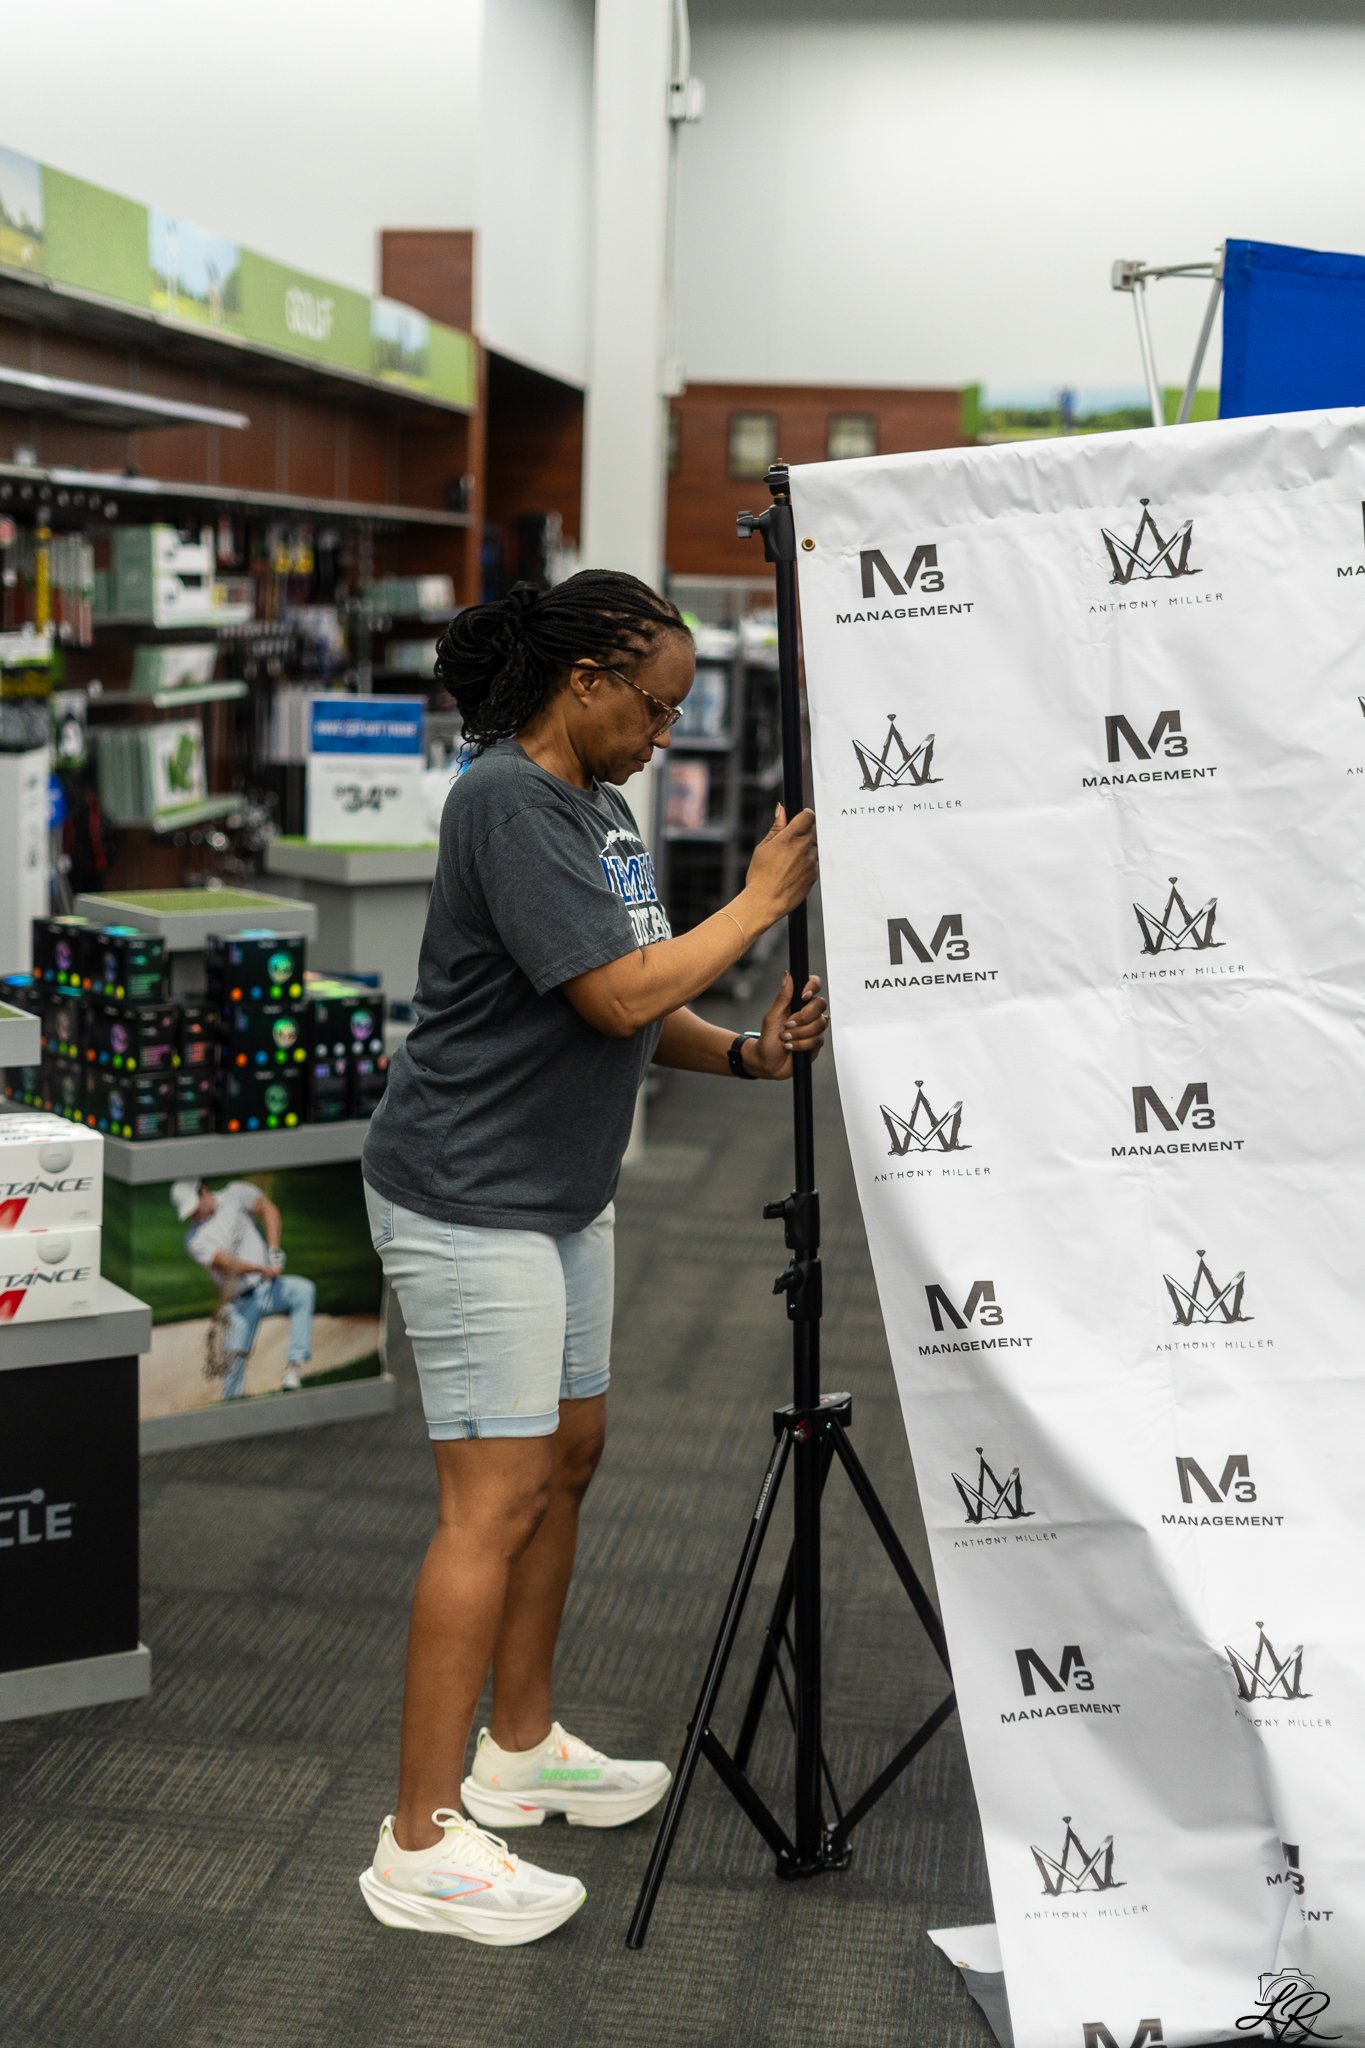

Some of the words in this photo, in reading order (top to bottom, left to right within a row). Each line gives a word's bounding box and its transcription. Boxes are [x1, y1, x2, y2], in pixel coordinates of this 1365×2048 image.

[859, 543, 945, 599] M3
[1088, 599, 1158, 614] ANTHONY
[1168, 592, 1224, 606] MILLER
[835, 602, 975, 625] MANAGEMENT
[1104, 709, 1189, 764] M3
[1082, 766, 1218, 788] MANAGEMENT
[840, 803, 904, 816] ANTHONY
[913, 799, 962, 811] MILLER
[886, 913, 971, 966] M3
[864, 970, 999, 990] MANAGEMENT
[1122, 968, 1185, 980] ANTHONY
[1195, 964, 1245, 975] MILLER
[1131, 1081, 1216, 1134] M3
[1111, 1140, 1245, 1157] MANAGEMENT
[874, 1169, 933, 1183] ANTHONY
[942, 1167, 991, 1177] MILLER
[924, 1280, 1004, 1332] M3
[918, 1337, 1033, 1356] MANAGEMENT
[1155, 1341, 1216, 1352] ANTHONY
[1224, 1339, 1274, 1349] MILLER
[1175, 1454, 1258, 1504] M3
[1161, 1514, 1285, 1527] MANAGEMENT
[953, 1535, 1008, 1549] ANTHONY
[1014, 1532, 1058, 1543] MILLER
[1014, 1644, 1095, 1697] M3
[1000, 1703, 1121, 1724] MANAGEMENT
[1288, 1718, 1332, 1727] MILLER
[1024, 1911, 1088, 1921] ANTHONY
[1097, 1904, 1149, 1918] MILLER
